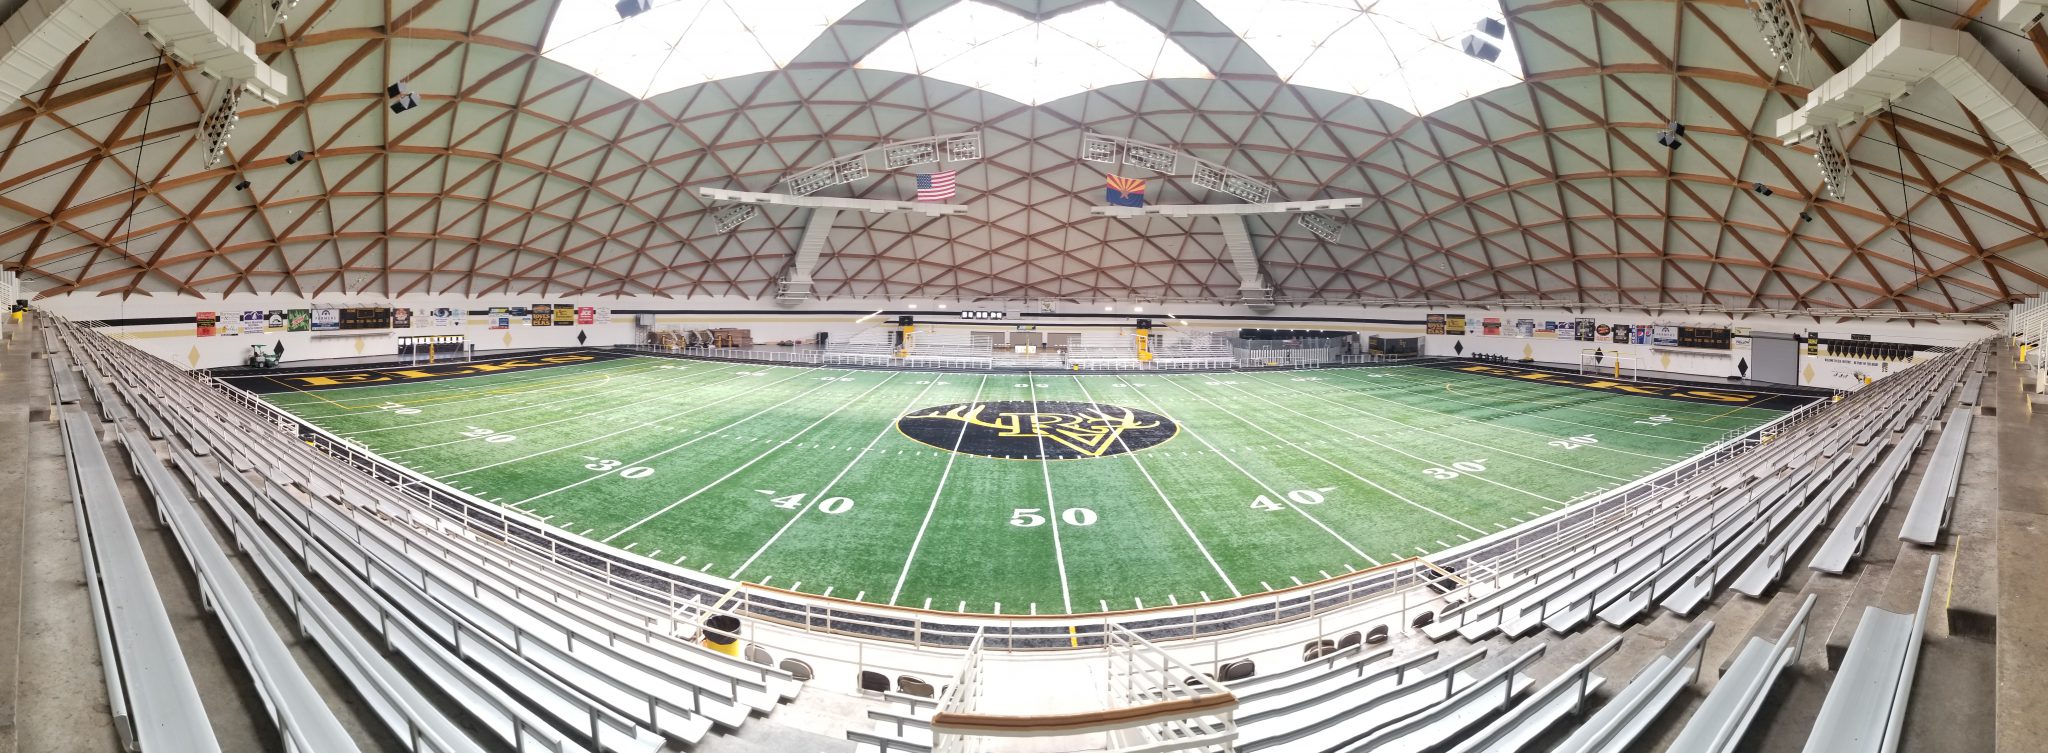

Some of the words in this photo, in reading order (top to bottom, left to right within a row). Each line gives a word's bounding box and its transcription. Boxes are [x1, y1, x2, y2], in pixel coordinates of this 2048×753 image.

[584, 459, 655, 479] 30
[1422, 460, 1487, 480] 30
[770, 493, 855, 514] 40
[1250, 489, 1325, 512] 40
[1010, 507, 1098, 527] 50
